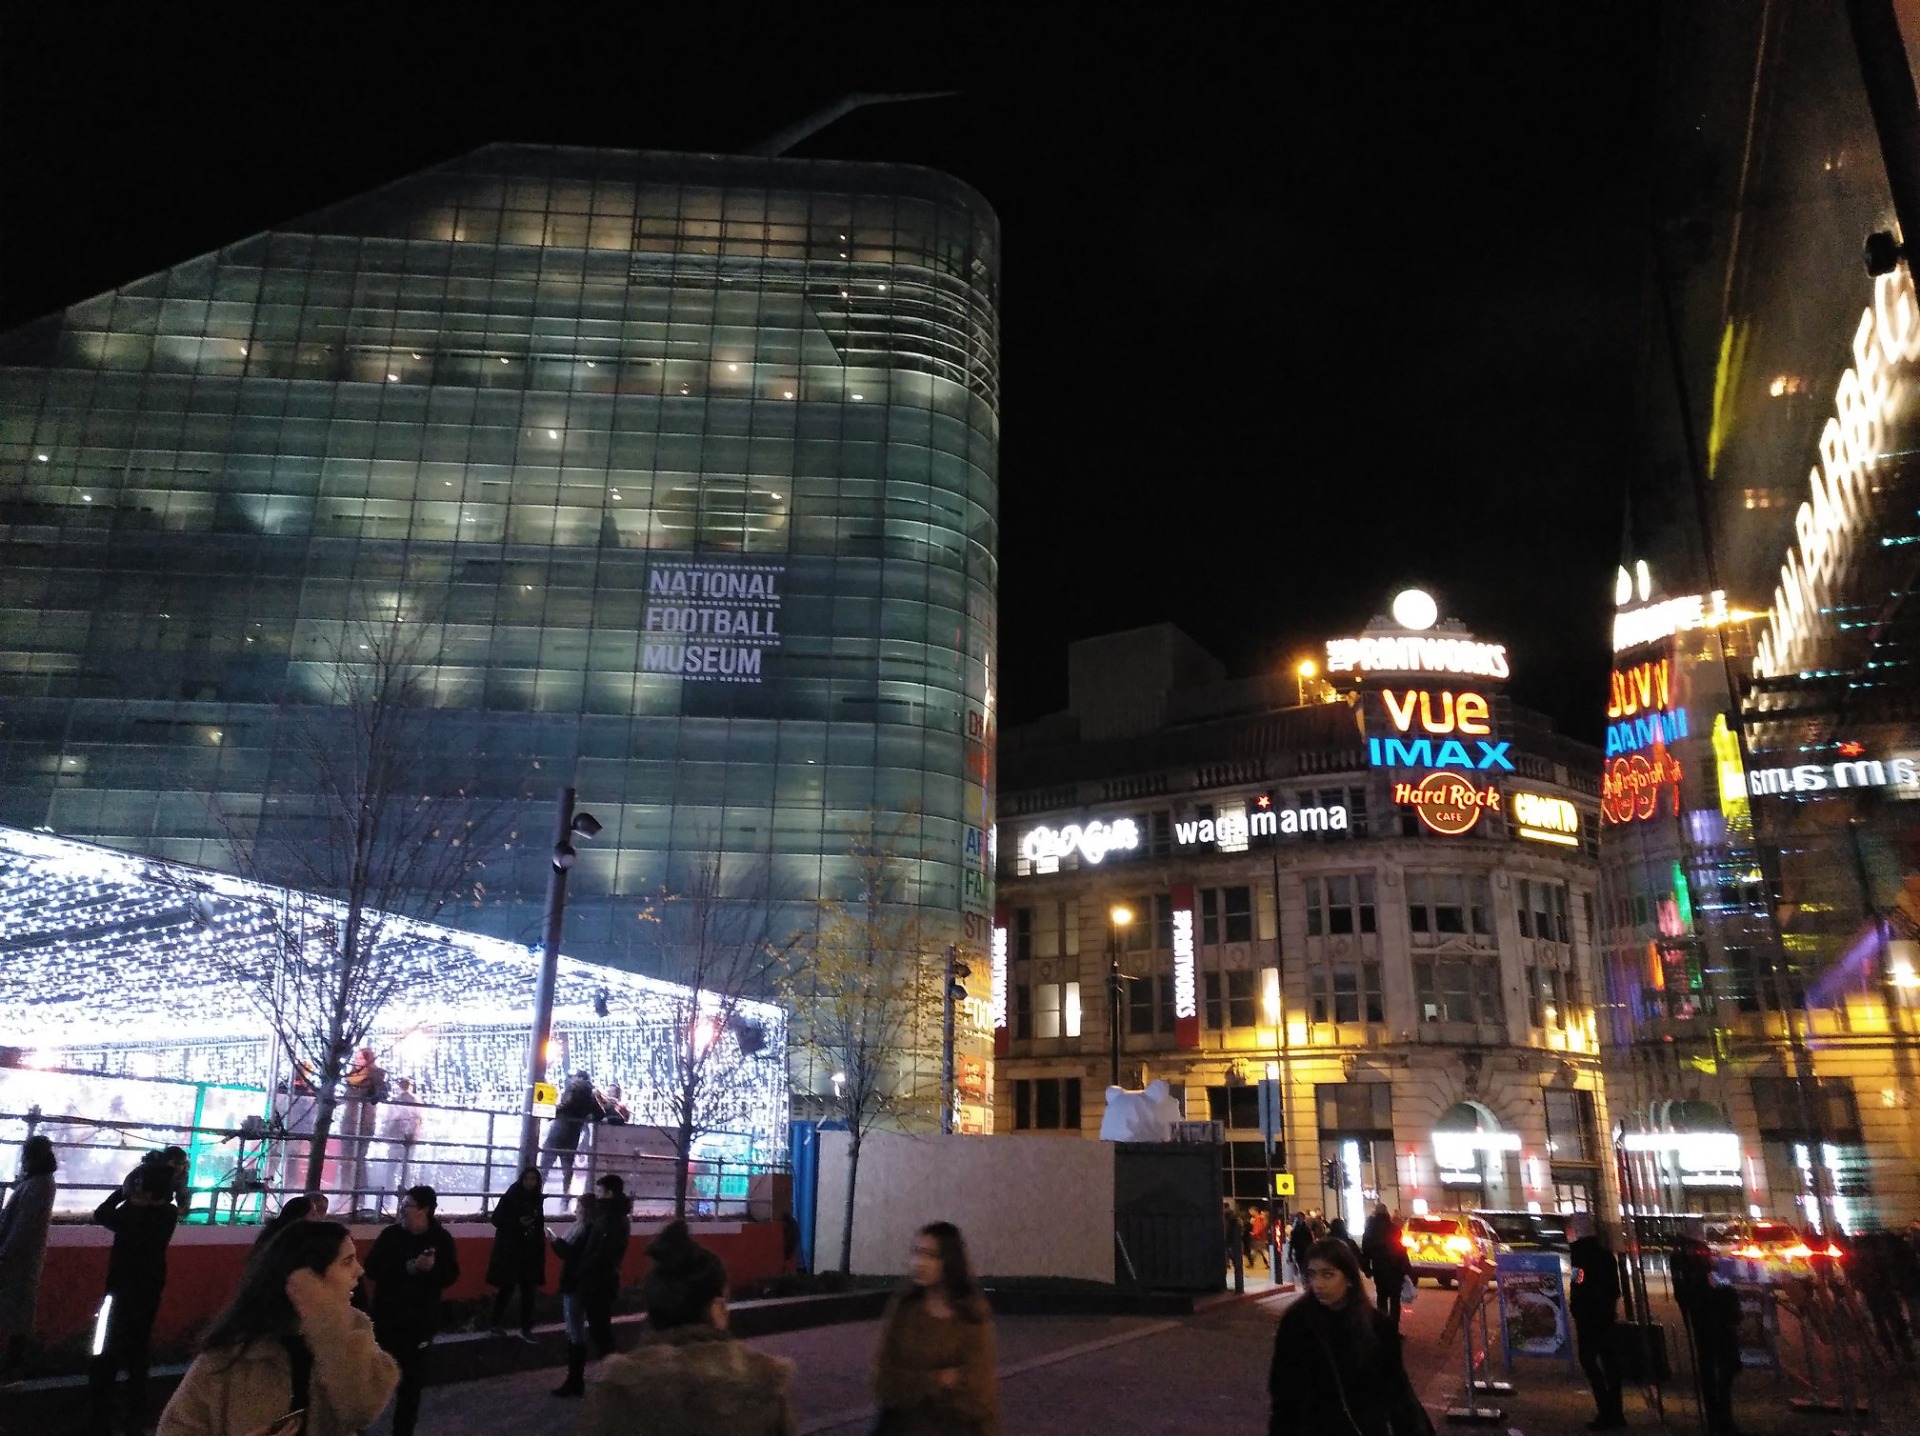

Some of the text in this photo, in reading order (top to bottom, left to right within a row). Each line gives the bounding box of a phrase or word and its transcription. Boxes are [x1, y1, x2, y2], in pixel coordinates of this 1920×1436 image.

[650, 570, 781, 600] NATIONAL
[646, 607, 780, 636] FOOTBALL
[642, 644, 762, 674] MUSEUM
[1342, 637, 1510, 678] PRINTWORKS
[1369, 737, 1516, 771] IMAX
[1395, 783, 1500, 811] Hard Rock
[1175, 805, 1348, 847] wagamama
[1435, 812, 1463, 822] CAFE
